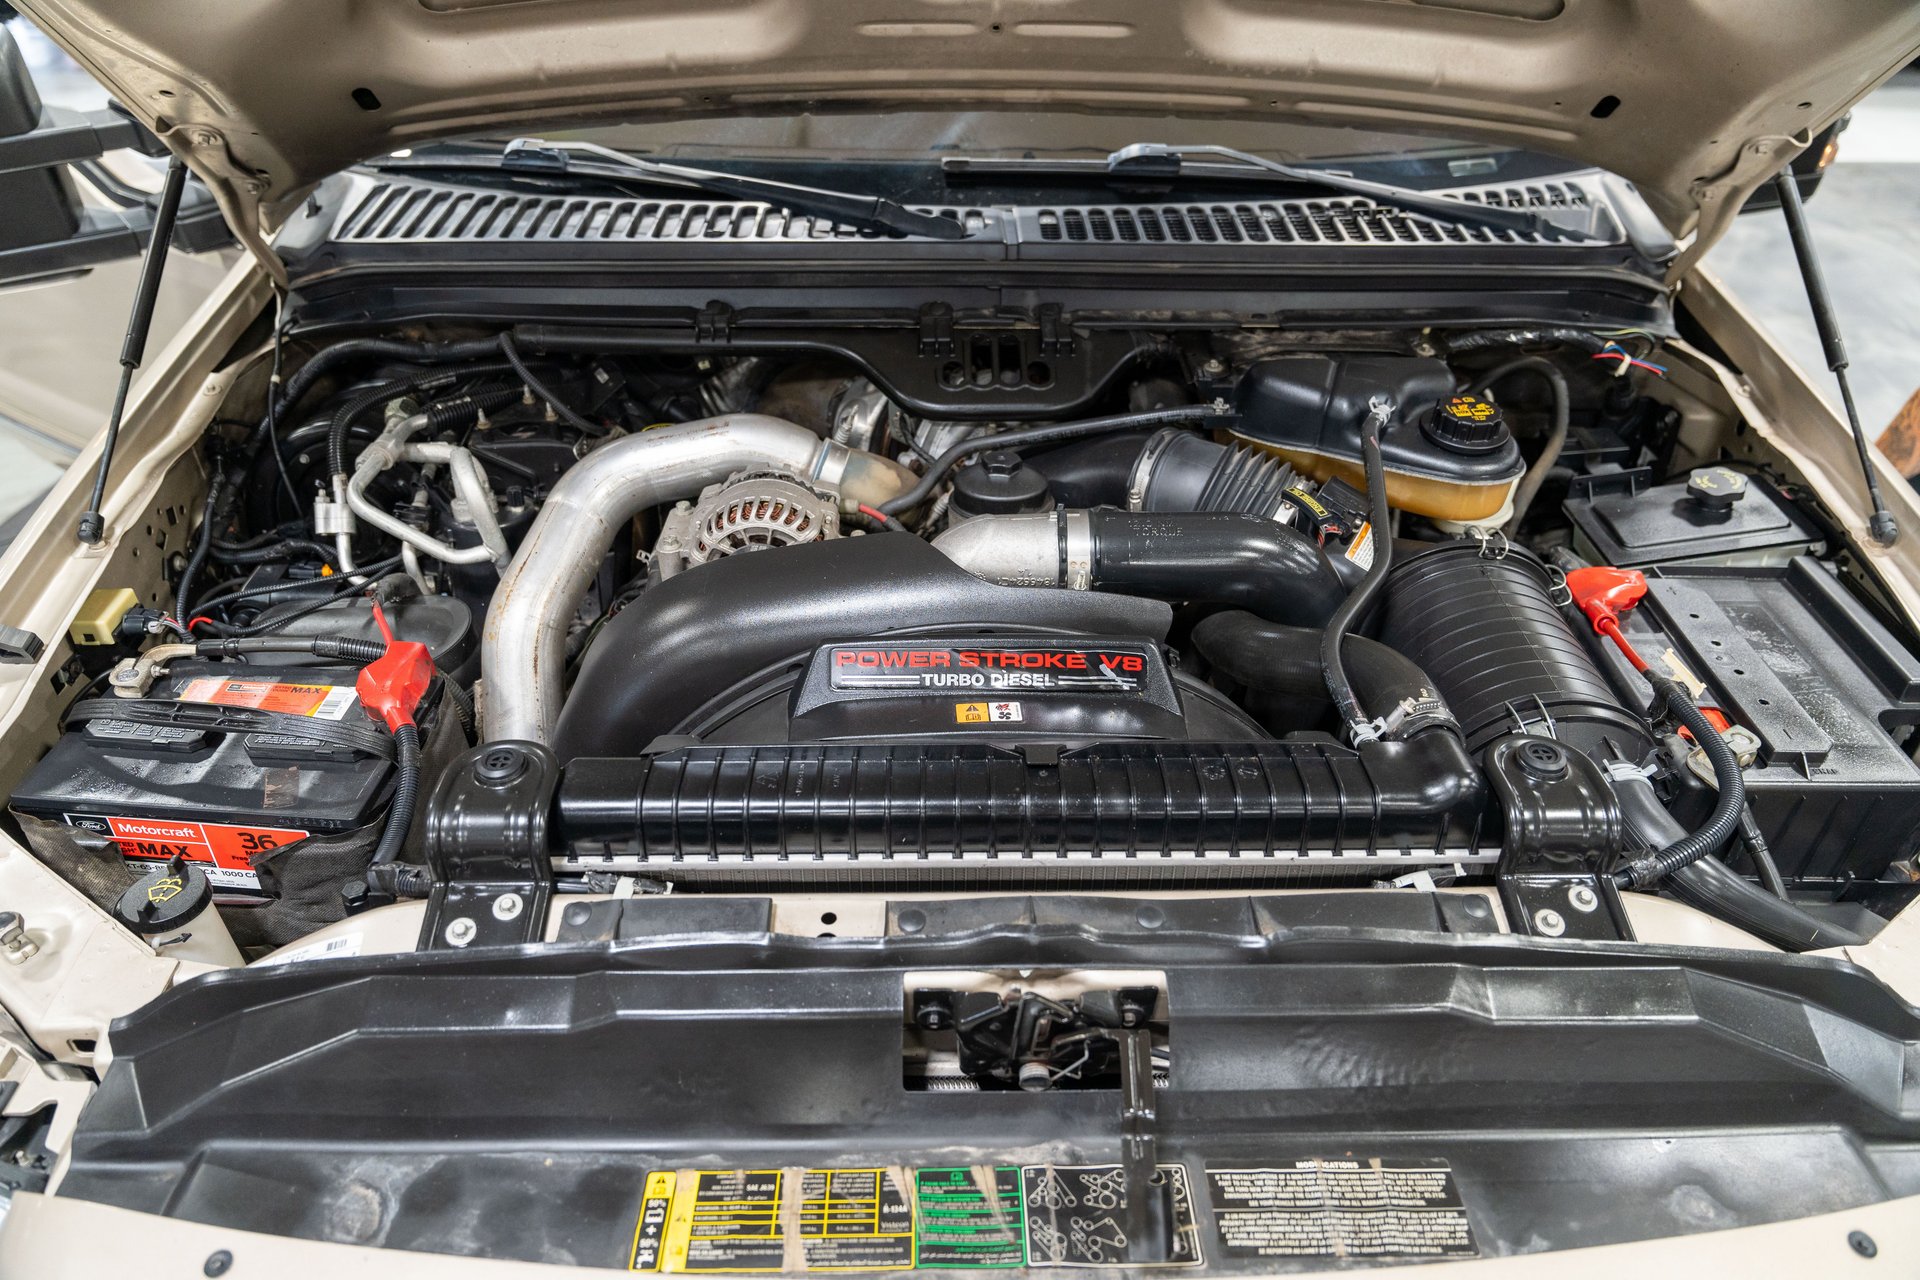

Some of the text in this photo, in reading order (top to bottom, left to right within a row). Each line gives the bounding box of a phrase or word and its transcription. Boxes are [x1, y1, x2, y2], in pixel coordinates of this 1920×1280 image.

[836, 650, 1143, 672] POWER STROKE V8
[922, 674, 1055, 688] TURBO DIESEL
[118, 824, 196, 838] Motorcraft
[237, 832, 279, 850] 36
[136, 842, 192, 857] MAX
[221, 870, 244, 878] 1000
[1295, 1161, 1359, 1169] MODIICATIONS
